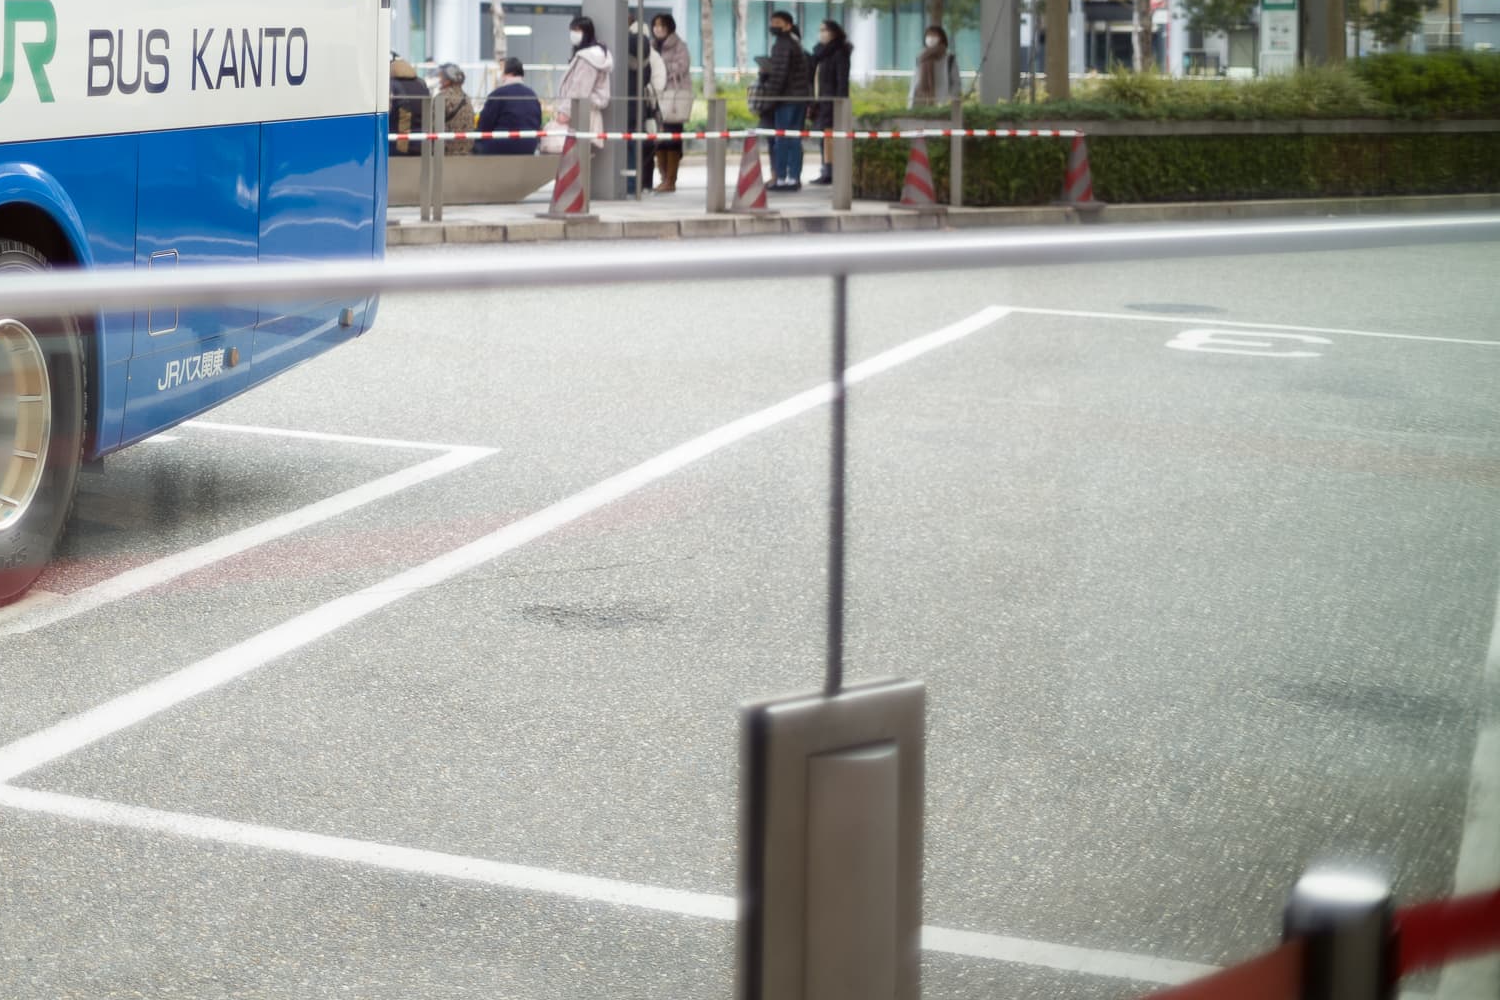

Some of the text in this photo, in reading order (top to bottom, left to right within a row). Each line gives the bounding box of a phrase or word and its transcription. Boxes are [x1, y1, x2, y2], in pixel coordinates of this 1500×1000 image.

[86, 28, 170, 97] BUS
[191, 27, 309, 91] KANTO
[158, 347, 225, 391] JRバス関東
